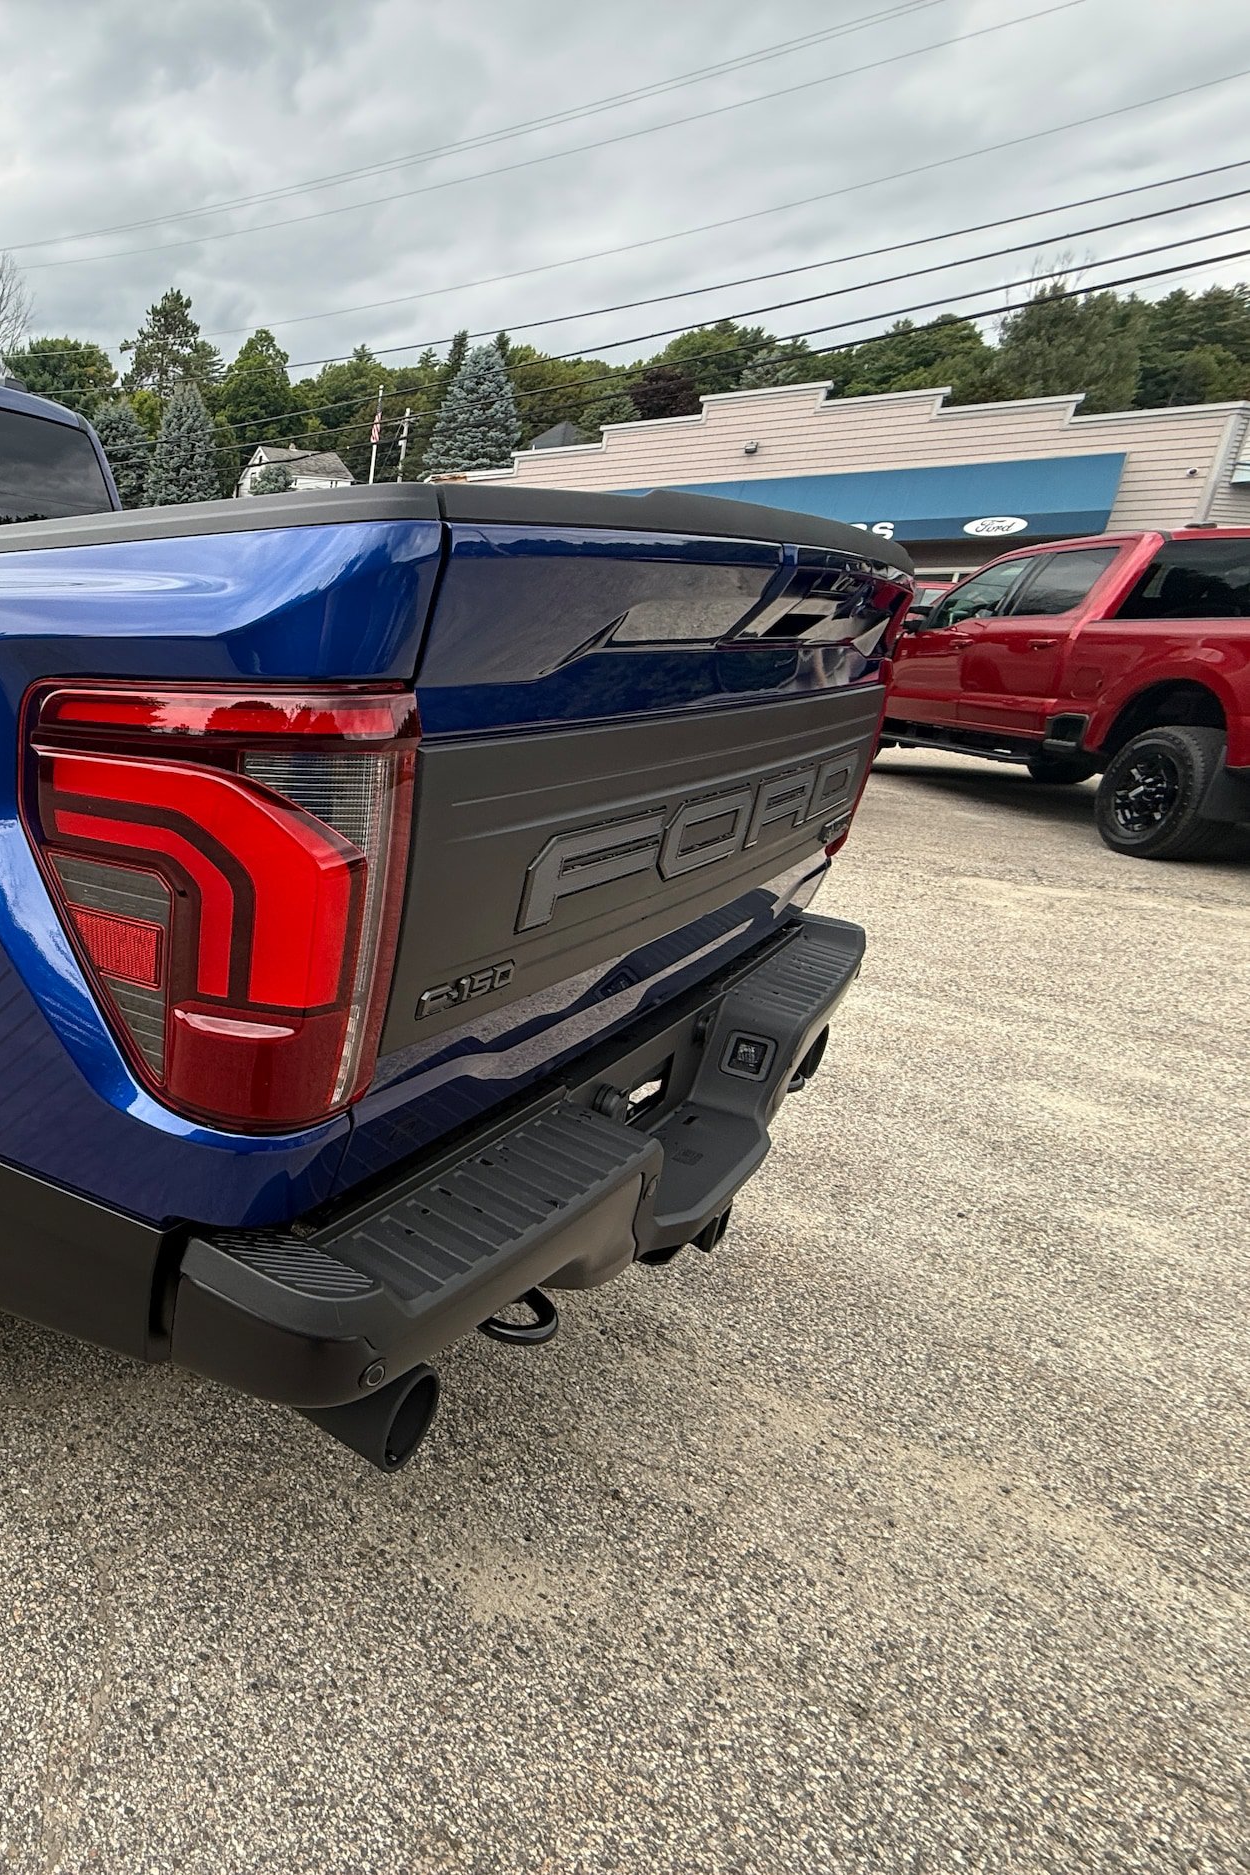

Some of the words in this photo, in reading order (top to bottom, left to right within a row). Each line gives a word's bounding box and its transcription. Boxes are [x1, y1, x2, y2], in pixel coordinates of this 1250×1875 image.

[975, 519, 1016, 533] Ford
[513, 747, 860, 935] FORD
[414, 959, 515, 1021] F-150
